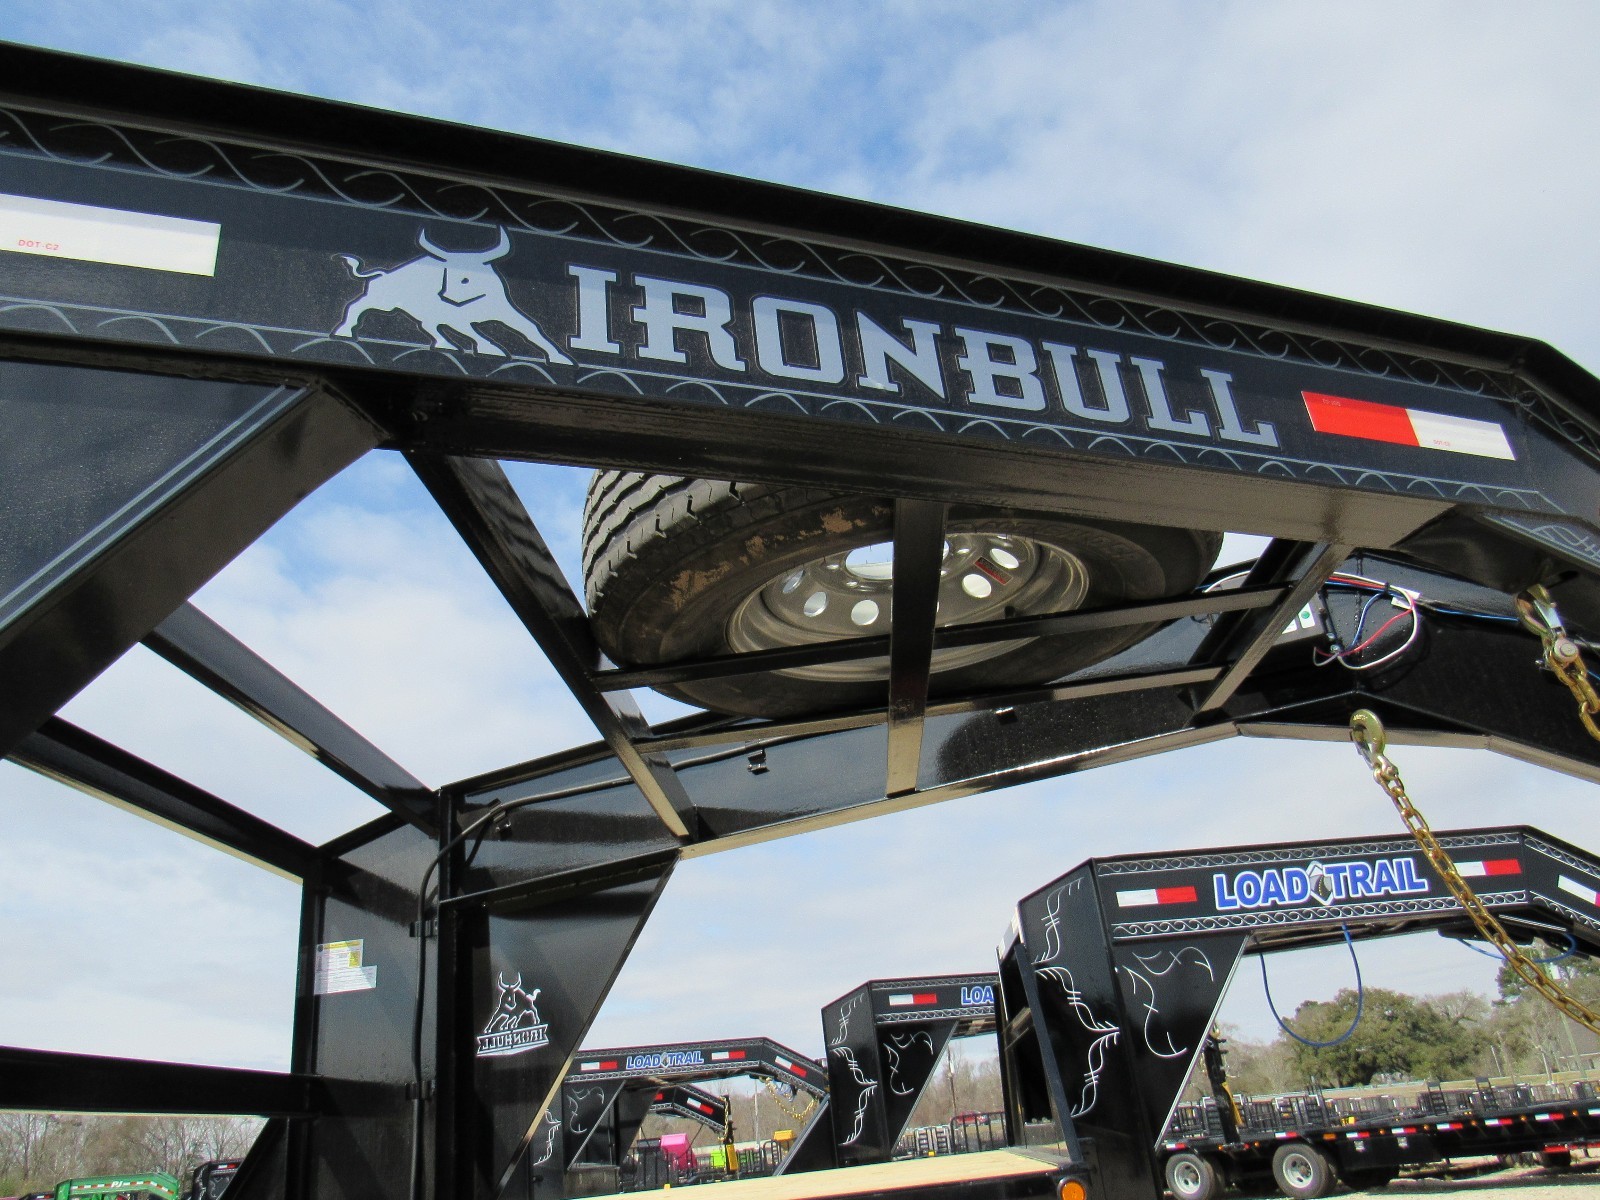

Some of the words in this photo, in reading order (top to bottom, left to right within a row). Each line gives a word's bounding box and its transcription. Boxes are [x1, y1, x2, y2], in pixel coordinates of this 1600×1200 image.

[18, 239, 60, 251] DOT-C2
[567, 265, 1280, 448] IRONBULL
[1213, 868, 1311, 910] LOAD
[1322, 857, 1429, 899] TRAIL
[626, 1054, 661, 1070] LOAD
[666, 1050, 704, 1066] TRAIL
